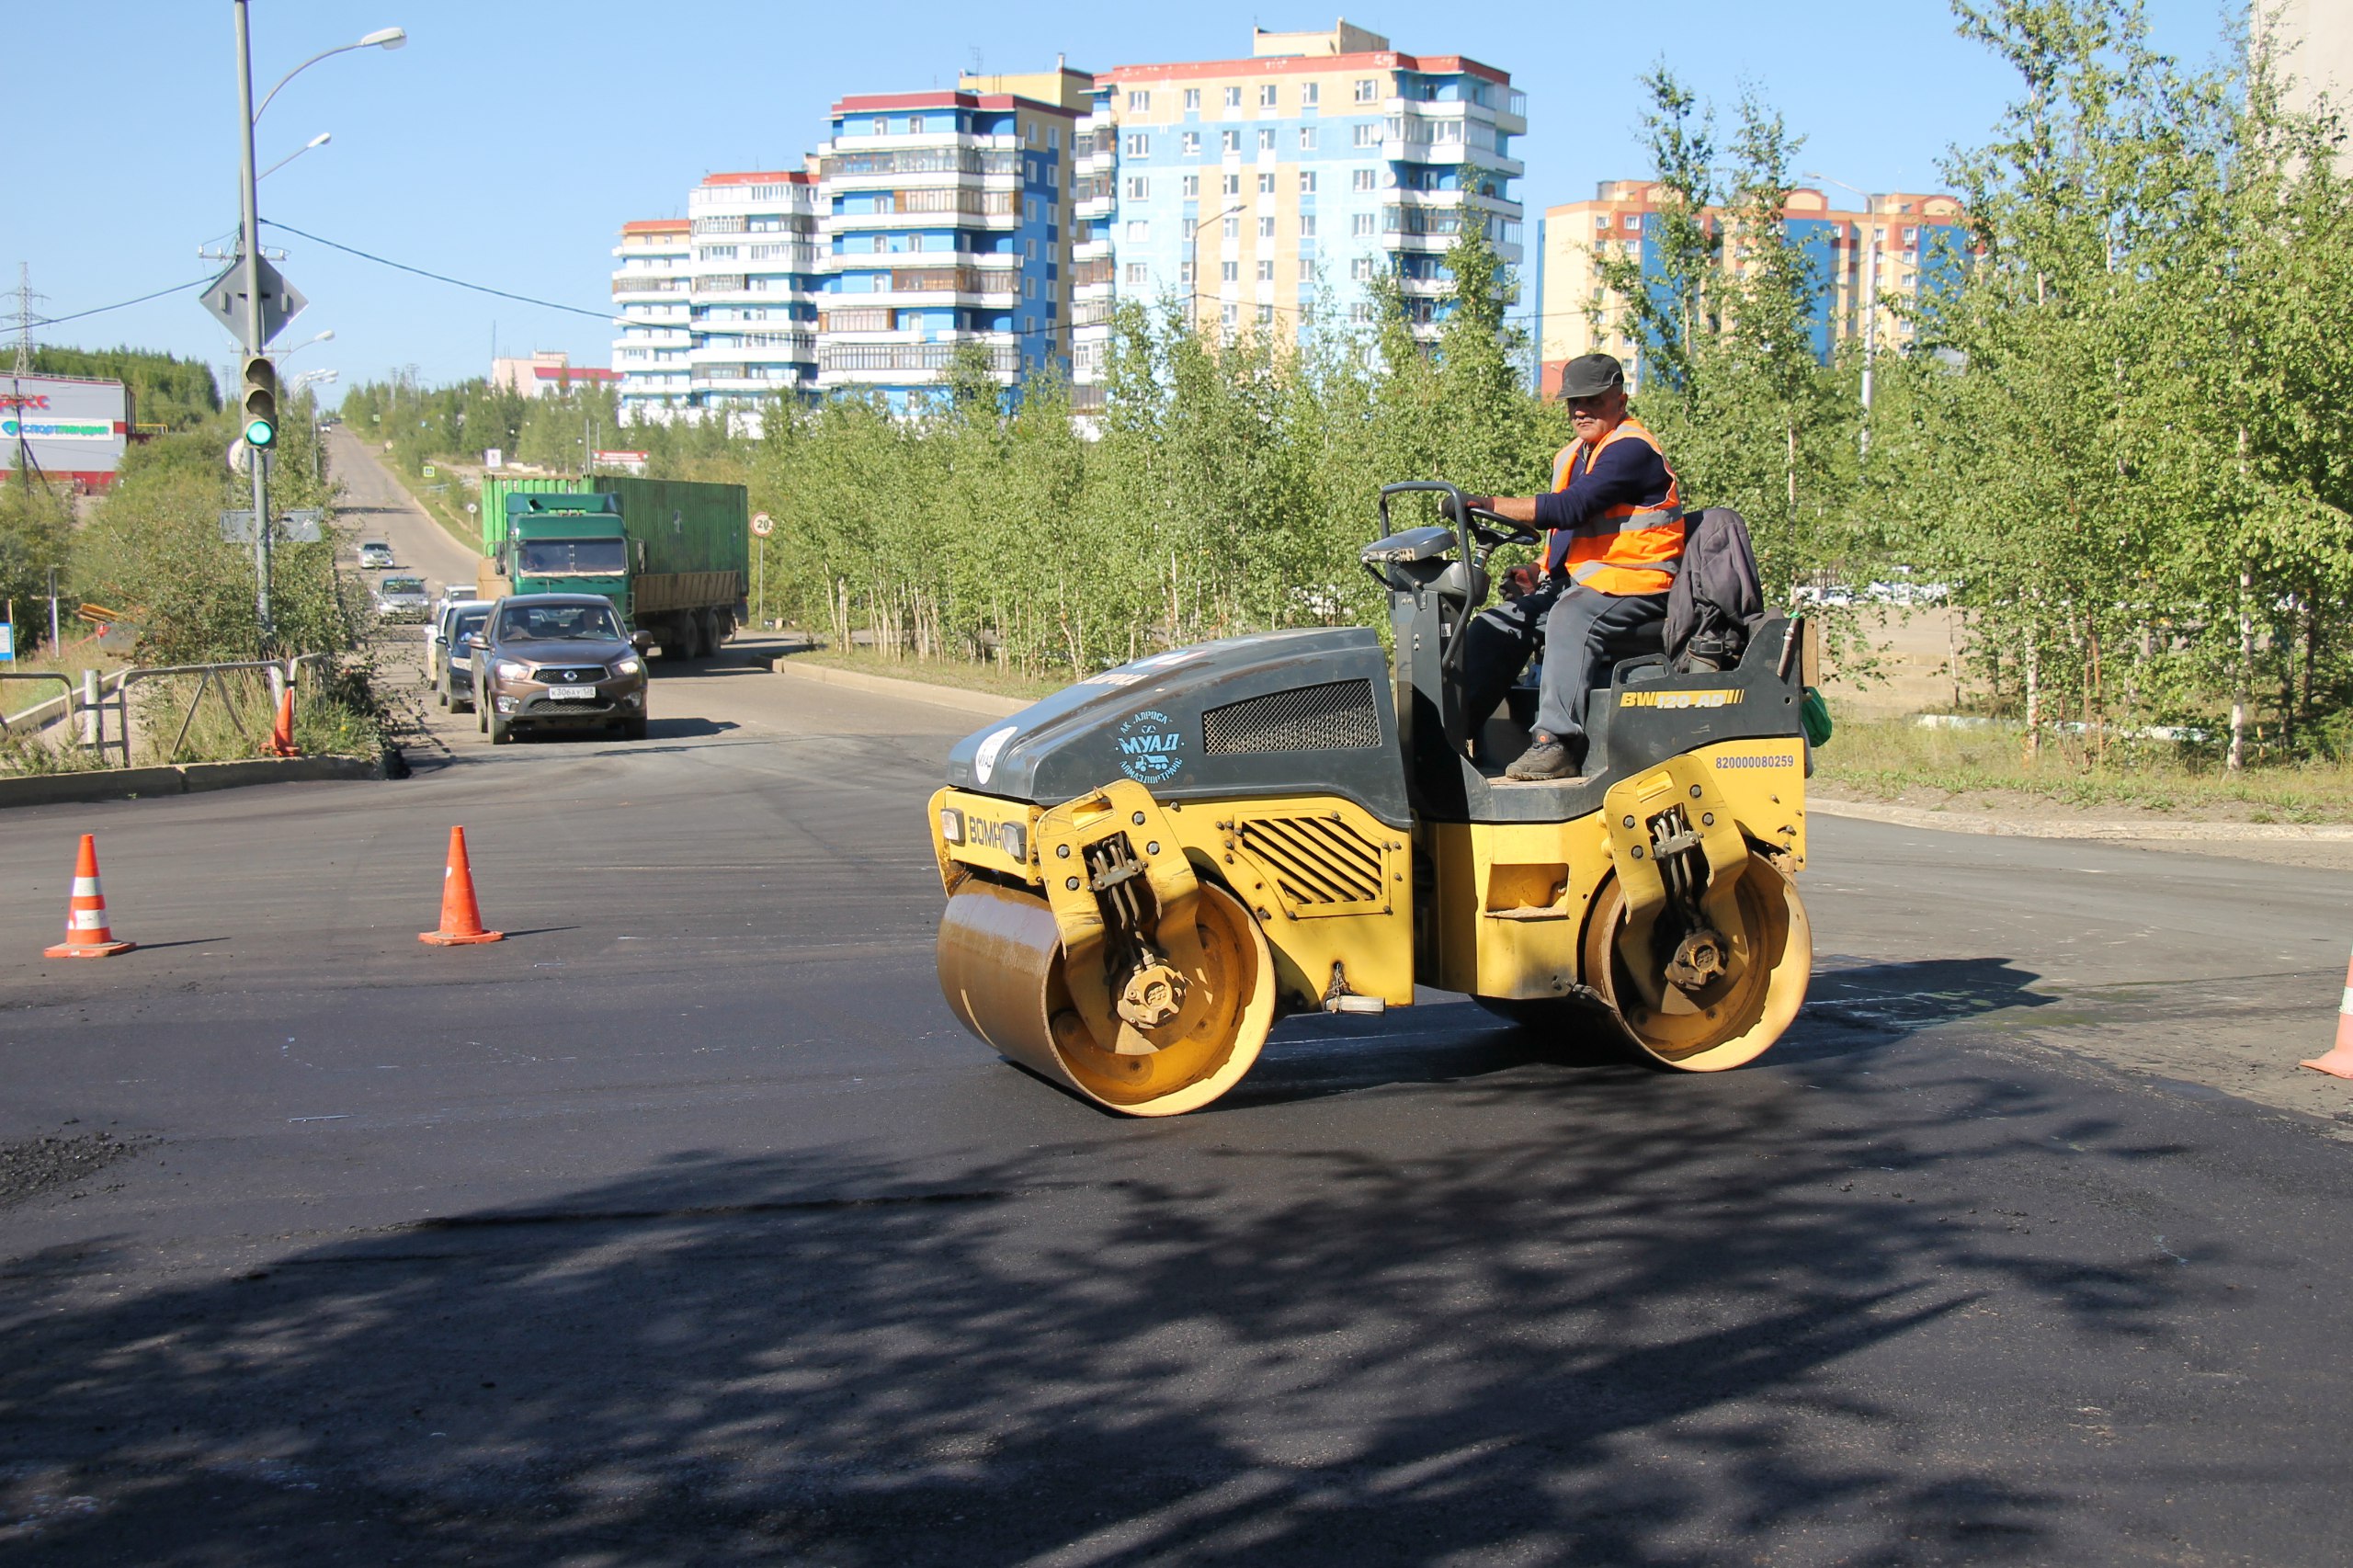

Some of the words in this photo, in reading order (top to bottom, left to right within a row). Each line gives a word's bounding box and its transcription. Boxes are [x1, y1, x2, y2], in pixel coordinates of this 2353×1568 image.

[756, 519, 770, 530] 20
[1694, 693, 1726, 709] AD
[1118, 733, 1180, 755] МУАД
[1715, 755, 1794, 769] 820000080259
[969, 815, 1006, 850] BOMA
